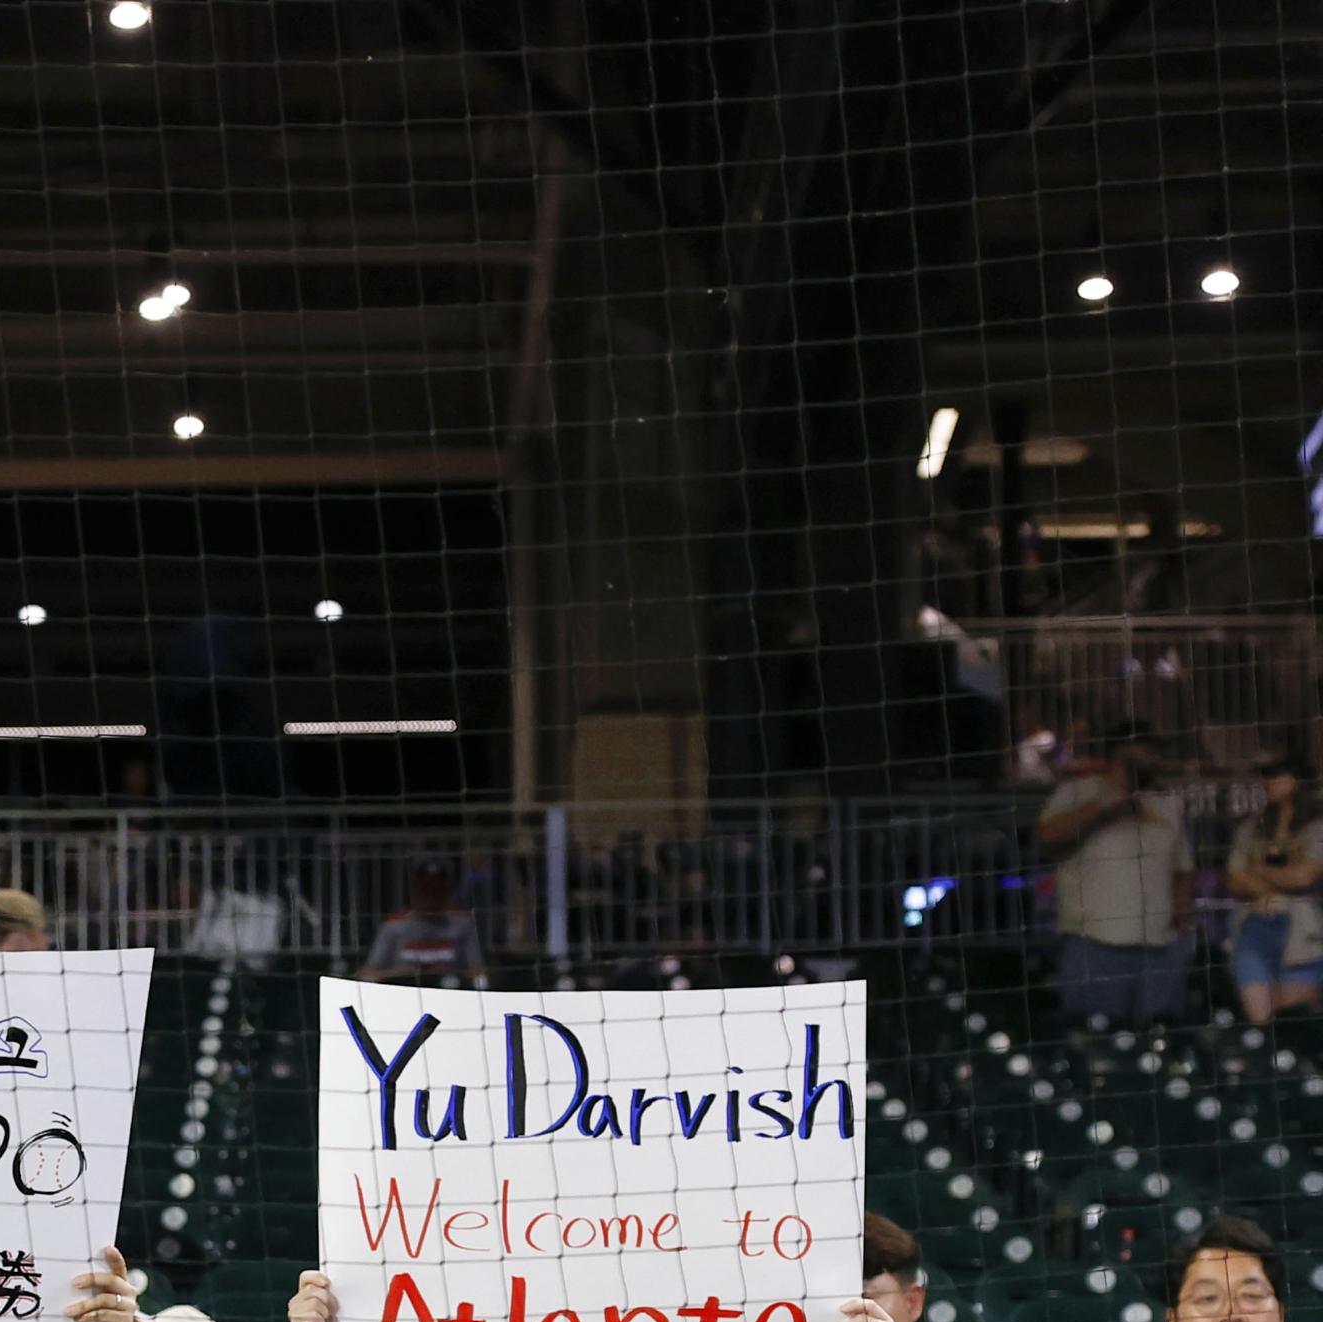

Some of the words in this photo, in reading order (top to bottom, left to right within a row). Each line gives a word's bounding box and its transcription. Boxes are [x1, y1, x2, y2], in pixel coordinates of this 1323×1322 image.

[340, 1005, 466, 1150] Yu
[504, 1012, 855, 1146] Darvish
[354, 1173, 687, 1258] Welcome
[723, 1209, 813, 1260] to
